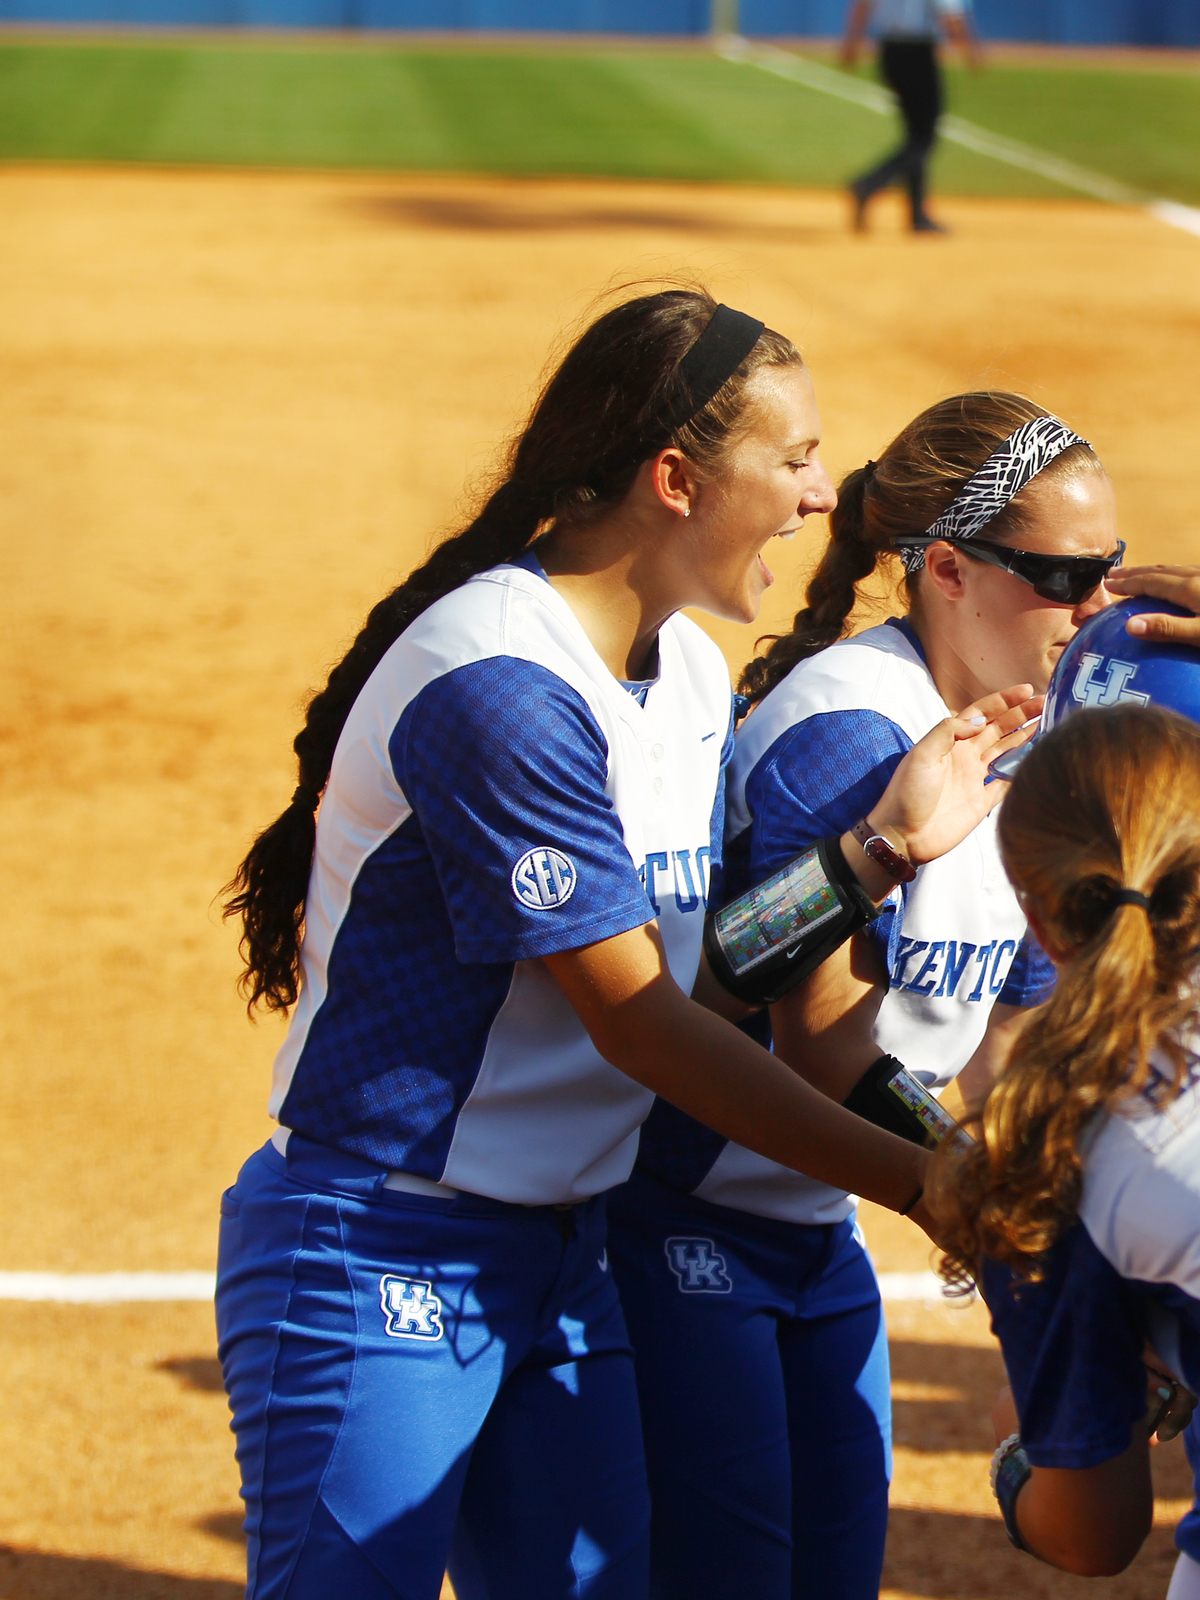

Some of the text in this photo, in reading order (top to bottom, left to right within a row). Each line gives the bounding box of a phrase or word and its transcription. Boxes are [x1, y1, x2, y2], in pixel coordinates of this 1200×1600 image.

[516, 850, 575, 907] SEC
[638, 846, 711, 916] TUC
[671, 1243, 723, 1288] UK
[385, 1279, 438, 1336] UK
